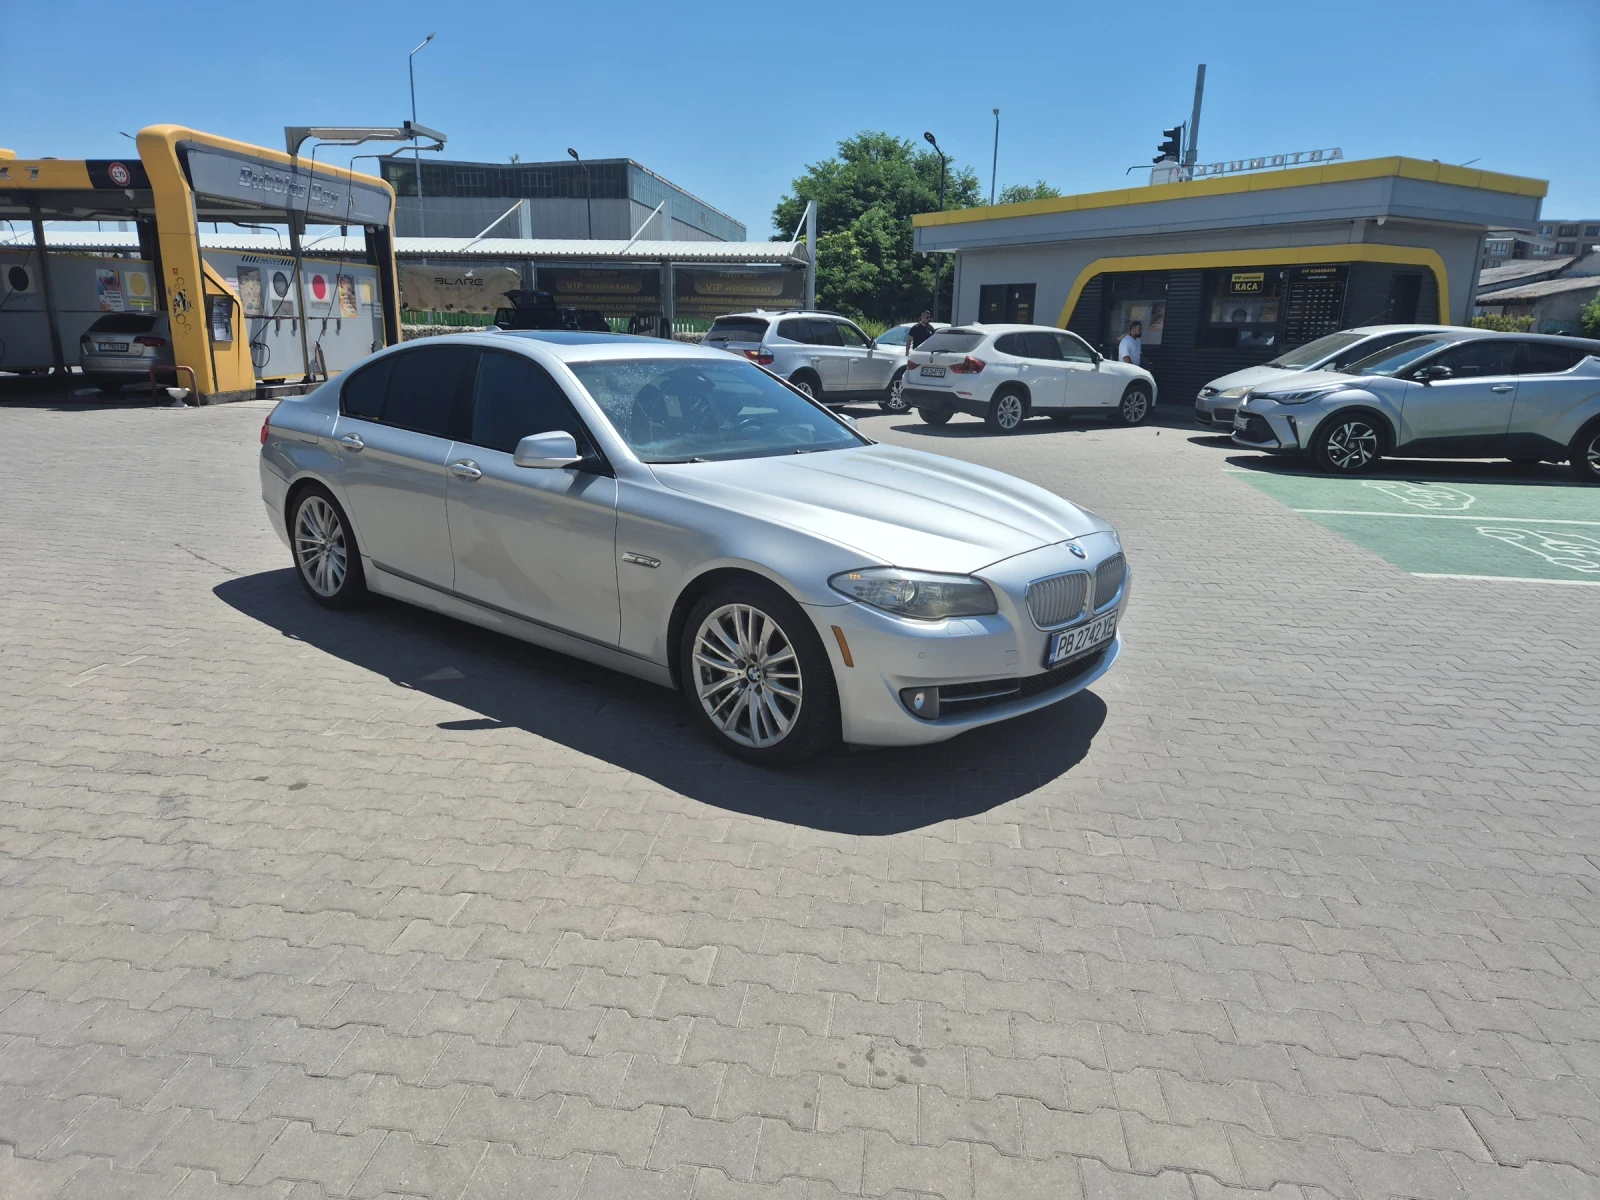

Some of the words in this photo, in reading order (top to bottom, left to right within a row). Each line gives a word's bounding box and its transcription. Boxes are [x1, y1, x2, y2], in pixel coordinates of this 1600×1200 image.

[238, 165, 306, 199] Bubbles
[310, 182, 341, 209] Bay
[566, 281, 584, 290] VIP
[705, 283, 723, 292] VIP
[725, 285, 772, 293] ИЗМИВАНЕ
[1235, 282, 1258, 291] КАСА
[1057, 633, 1075, 659] PB
[1075, 622, 1101, 651] 2742
[1101, 615, 1116, 640] XE
